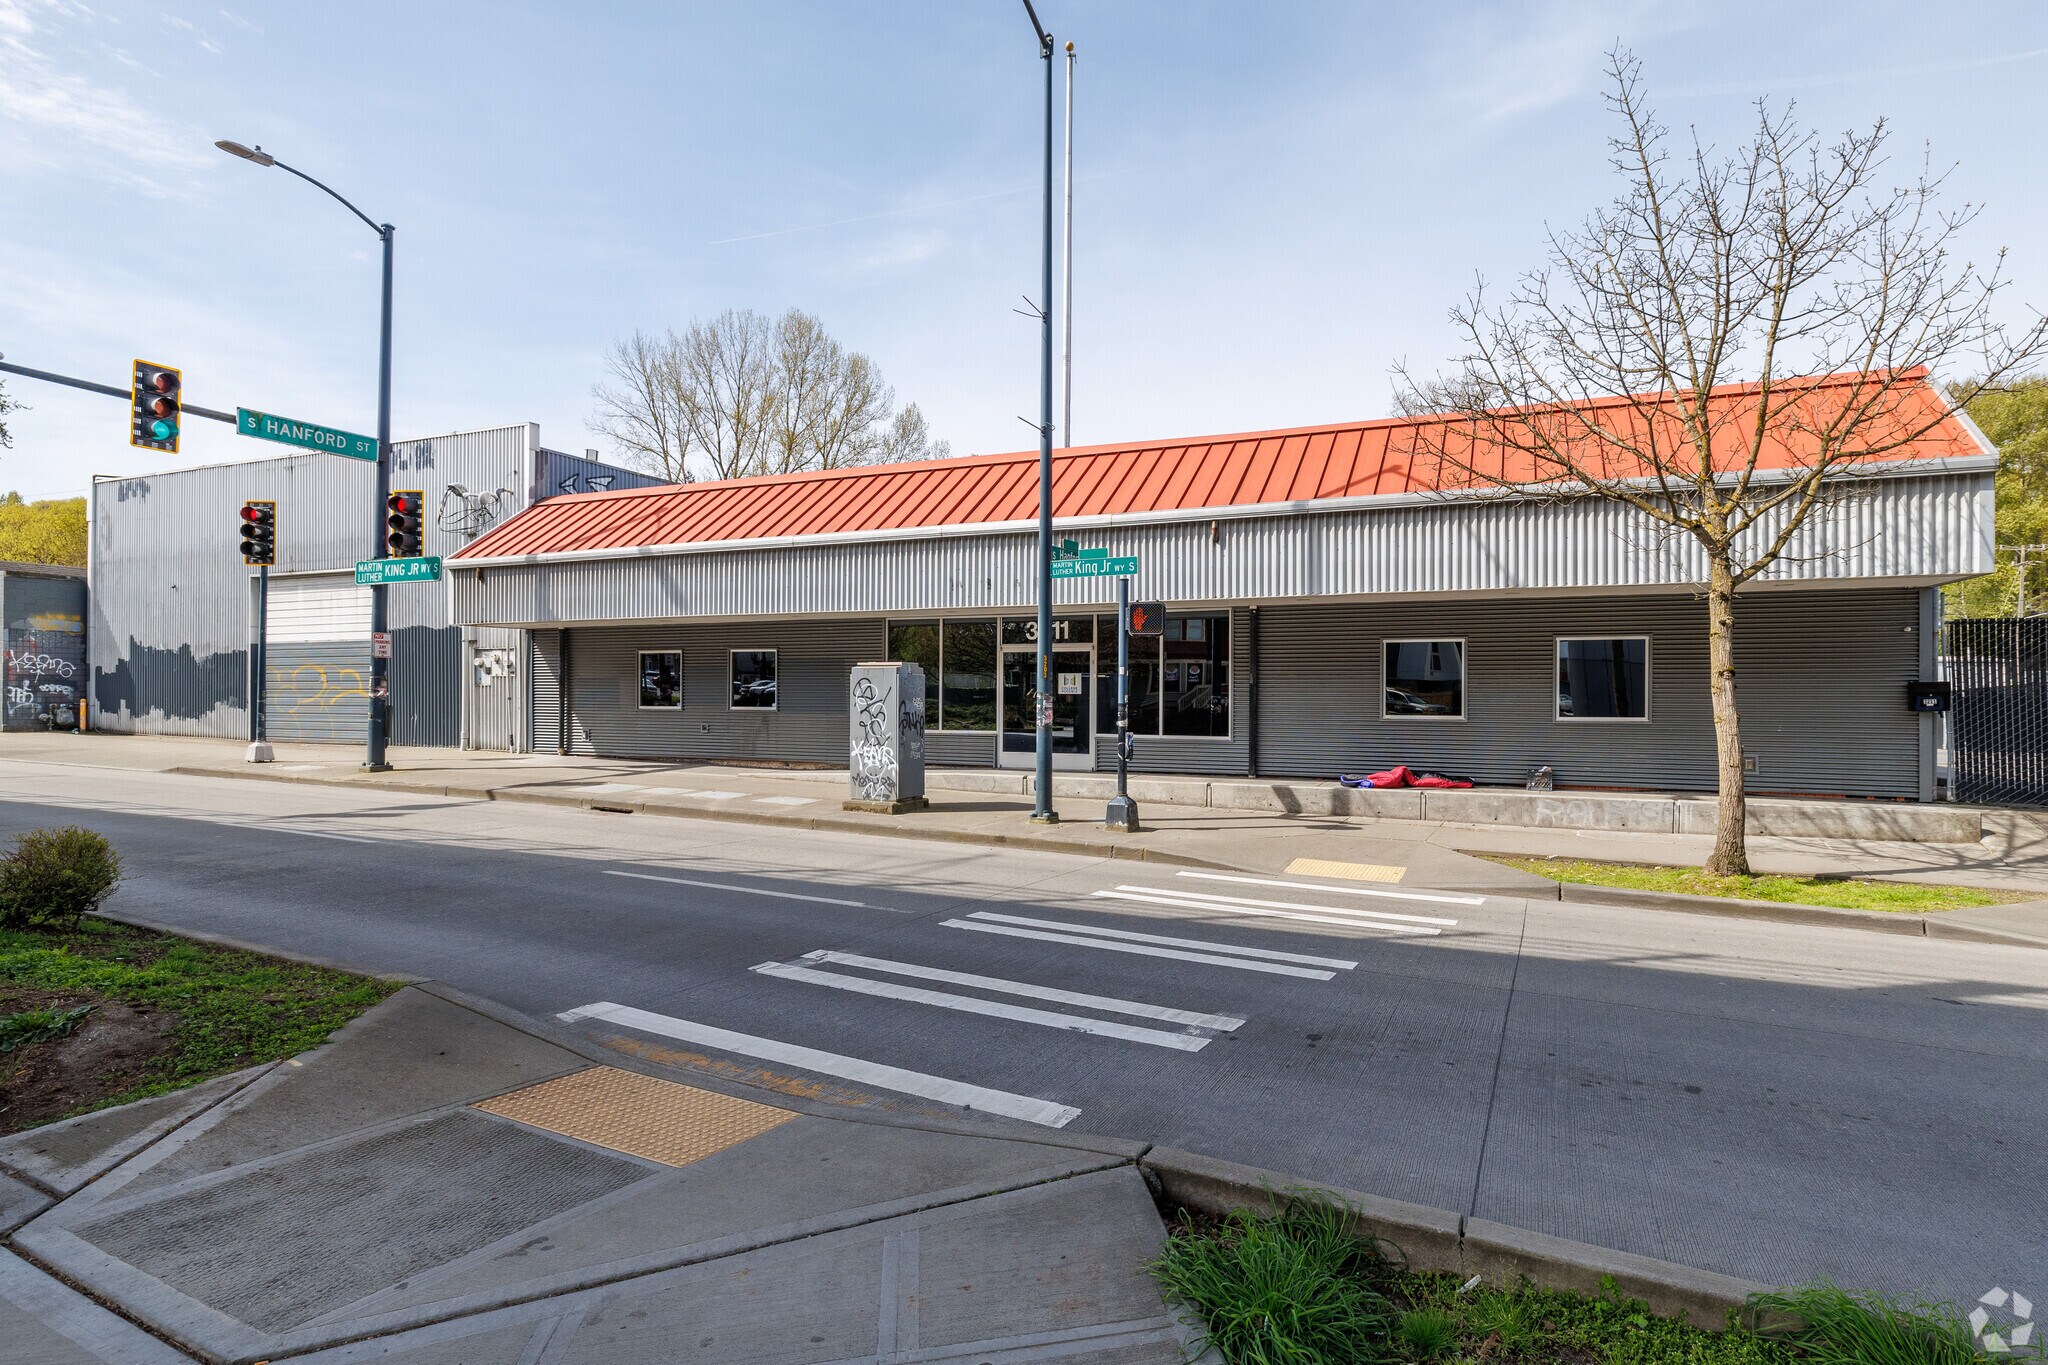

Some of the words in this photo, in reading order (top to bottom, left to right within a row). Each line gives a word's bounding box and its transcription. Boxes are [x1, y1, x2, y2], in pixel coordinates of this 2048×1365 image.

[248, 417, 256, 428] S
[267, 420, 347, 449] HANFORD
[356, 441, 370, 452] ST
[358, 563, 382, 573] MARTIN
[385, 564, 405, 577] KING
[408, 563, 419, 576] JR
[421, 564, 431, 573] WY
[433, 563, 438, 572] S
[1053, 561, 1073, 569] MARTIN
[1075, 560, 1098, 576] King
[1100, 560, 1111, 573] Jr
[1129, 562, 1134, 571] S
[358, 572, 382, 582] LUTHER
[1053, 568, 1073, 576] LUTHER
[1026, 621, 1069, 640] 311
